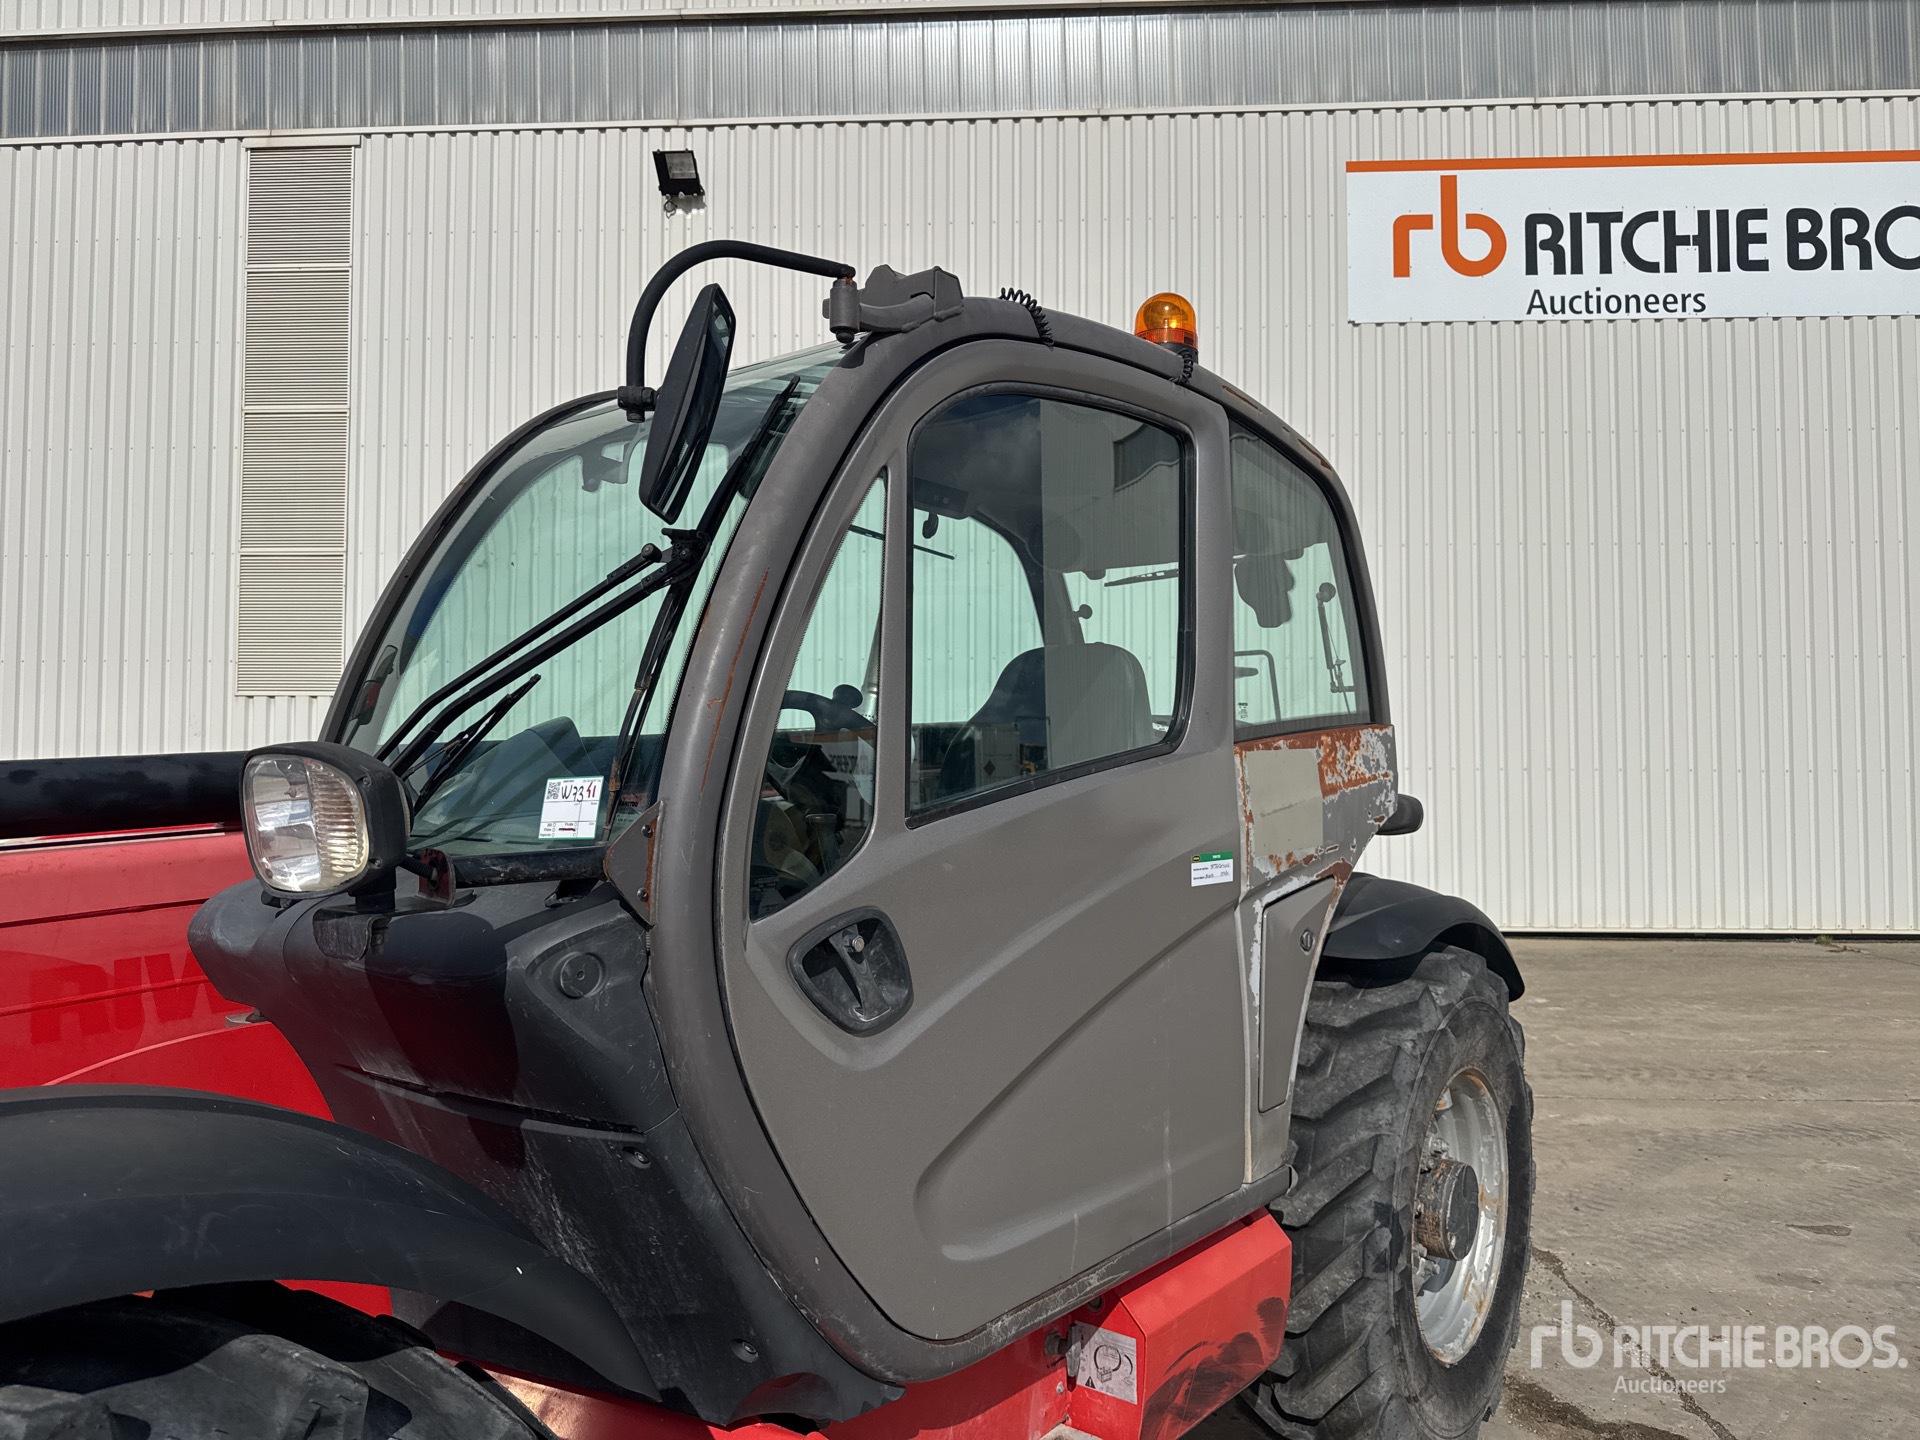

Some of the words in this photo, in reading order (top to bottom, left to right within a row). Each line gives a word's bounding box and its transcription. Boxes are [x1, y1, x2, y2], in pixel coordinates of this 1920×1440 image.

[1393, 175, 1507, 278] rb
[1525, 208, 1770, 276] RITCHIE
[1526, 286, 1707, 316] Auctioneers
